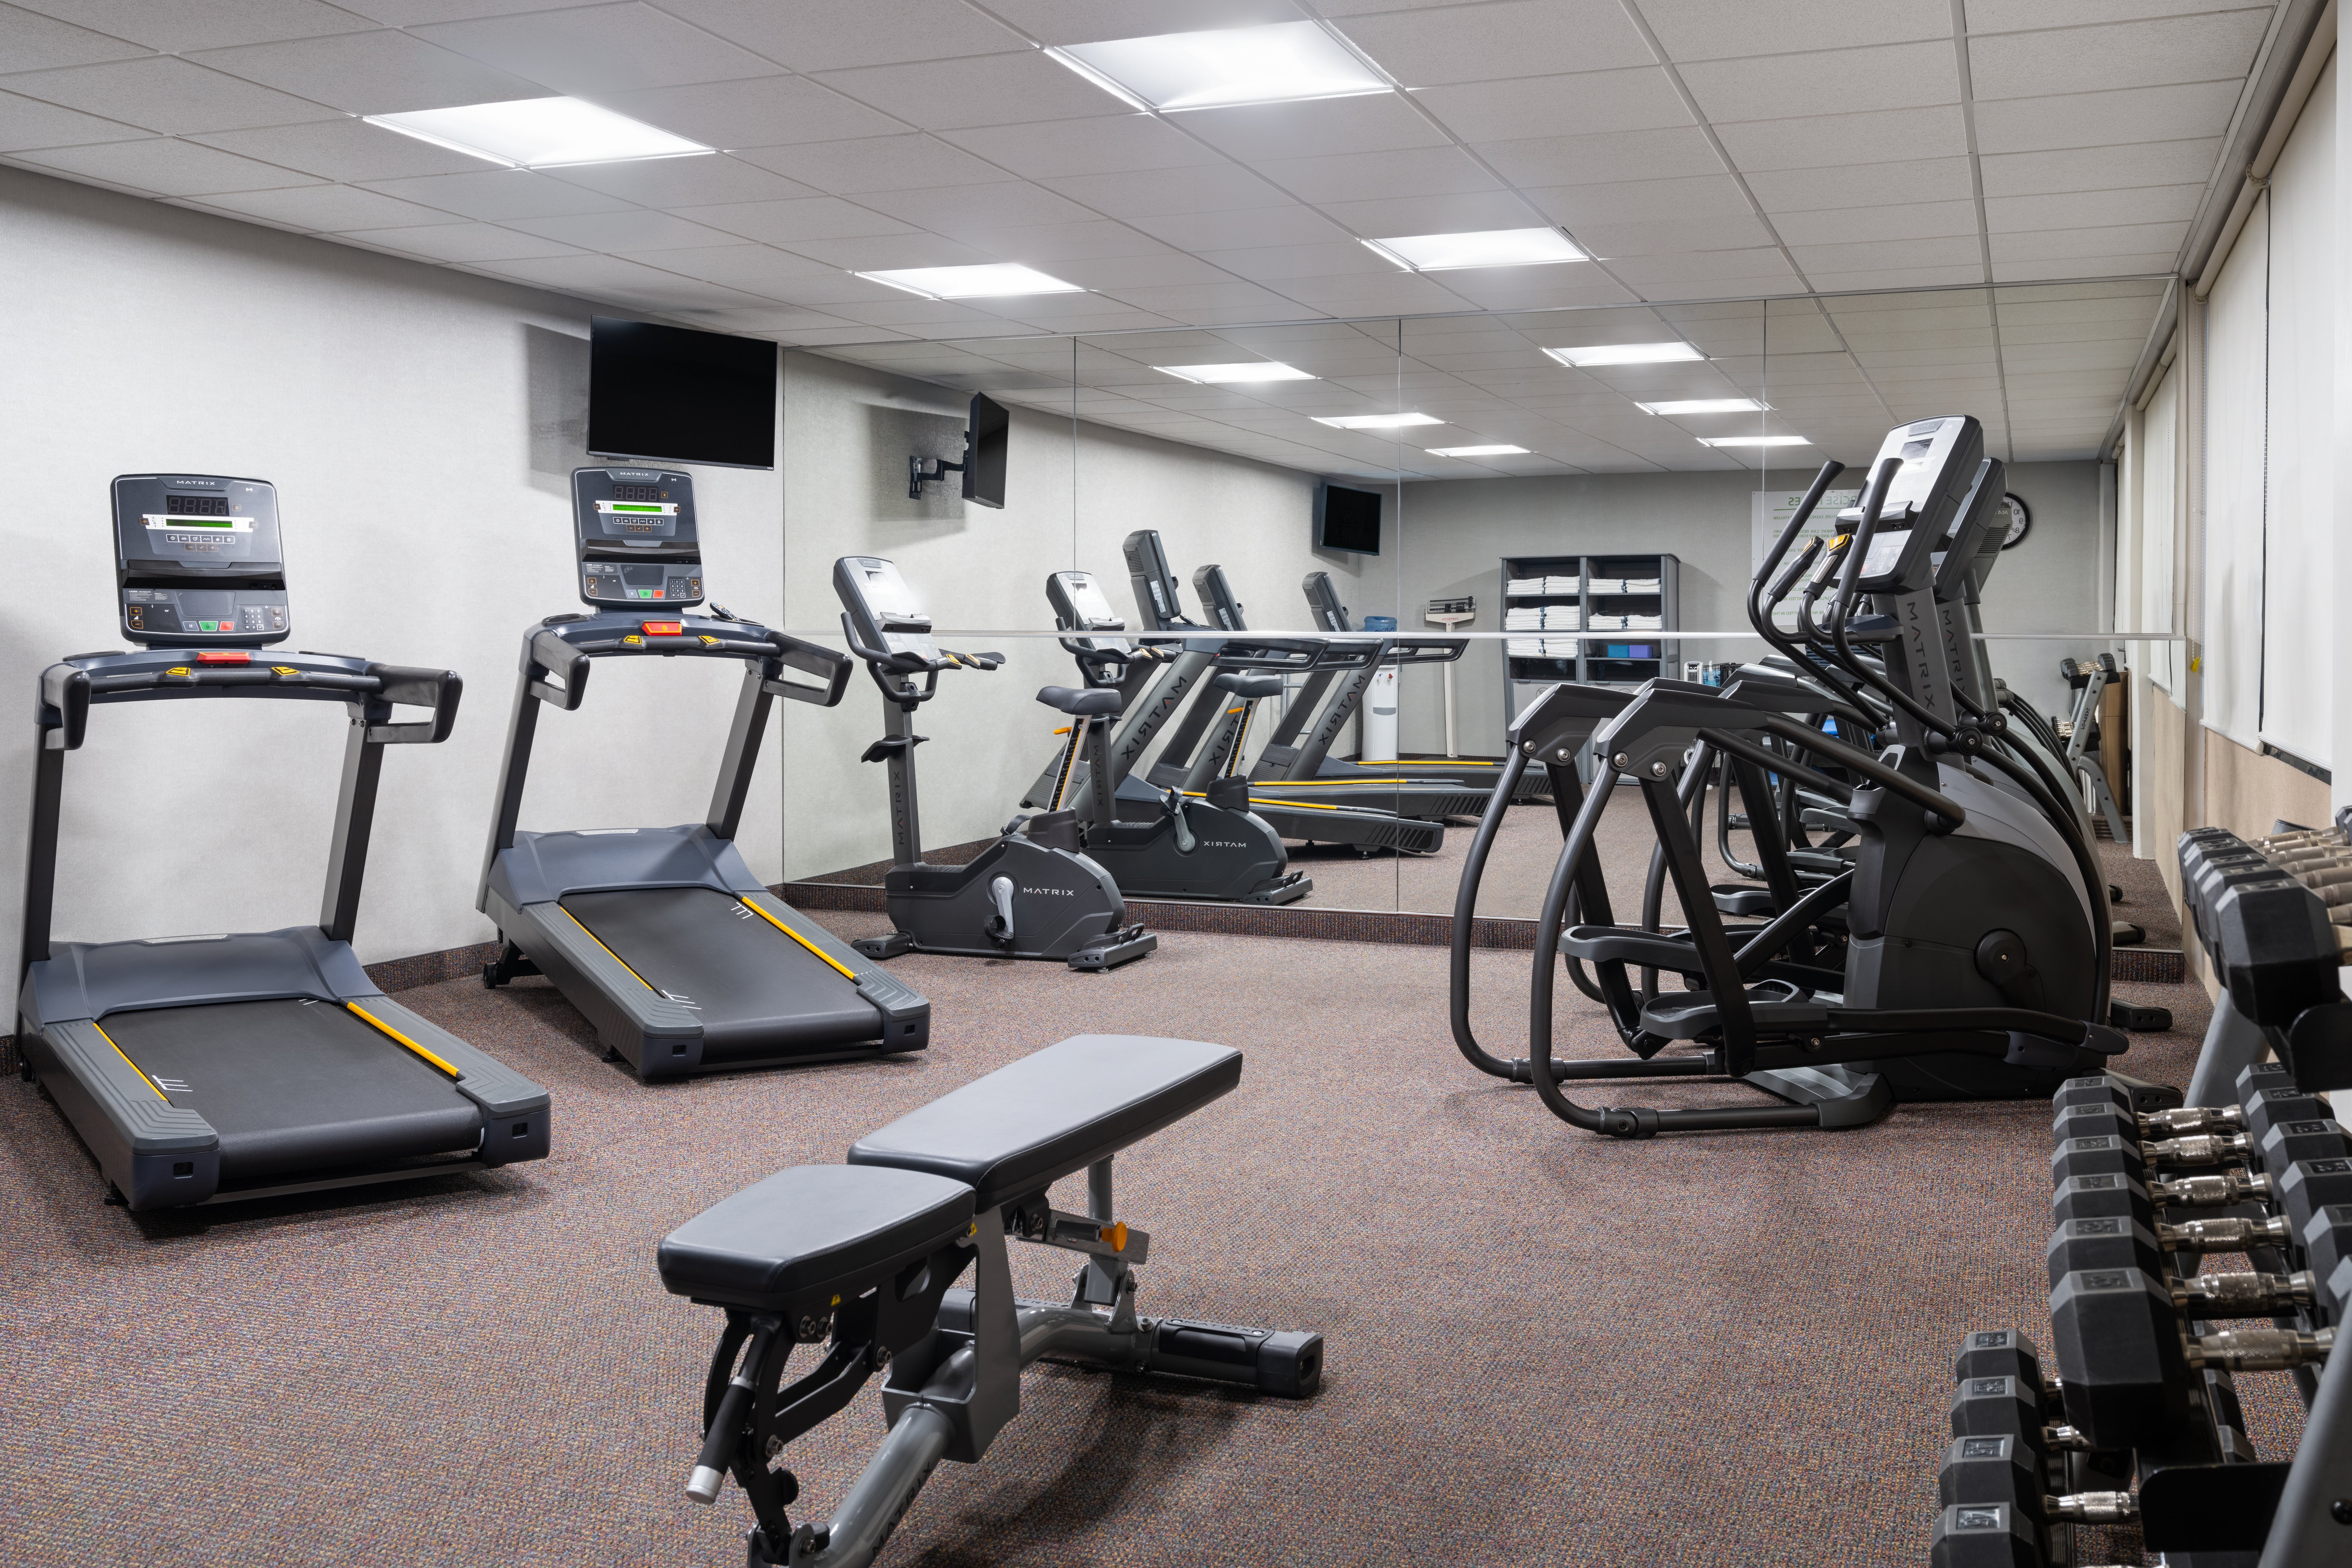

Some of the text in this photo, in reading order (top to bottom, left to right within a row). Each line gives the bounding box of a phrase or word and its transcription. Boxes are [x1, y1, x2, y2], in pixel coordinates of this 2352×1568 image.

[1915, 423, 1936, 432] MATRIX
[1907, 601, 1936, 709] MATRIX
[894, 770, 904, 845] MATRIX
[1023, 887, 1074, 896] MATRIX
[1185, 1320, 1251, 1332] MATRIX
[872, 1461, 932, 1557] MATRIX
